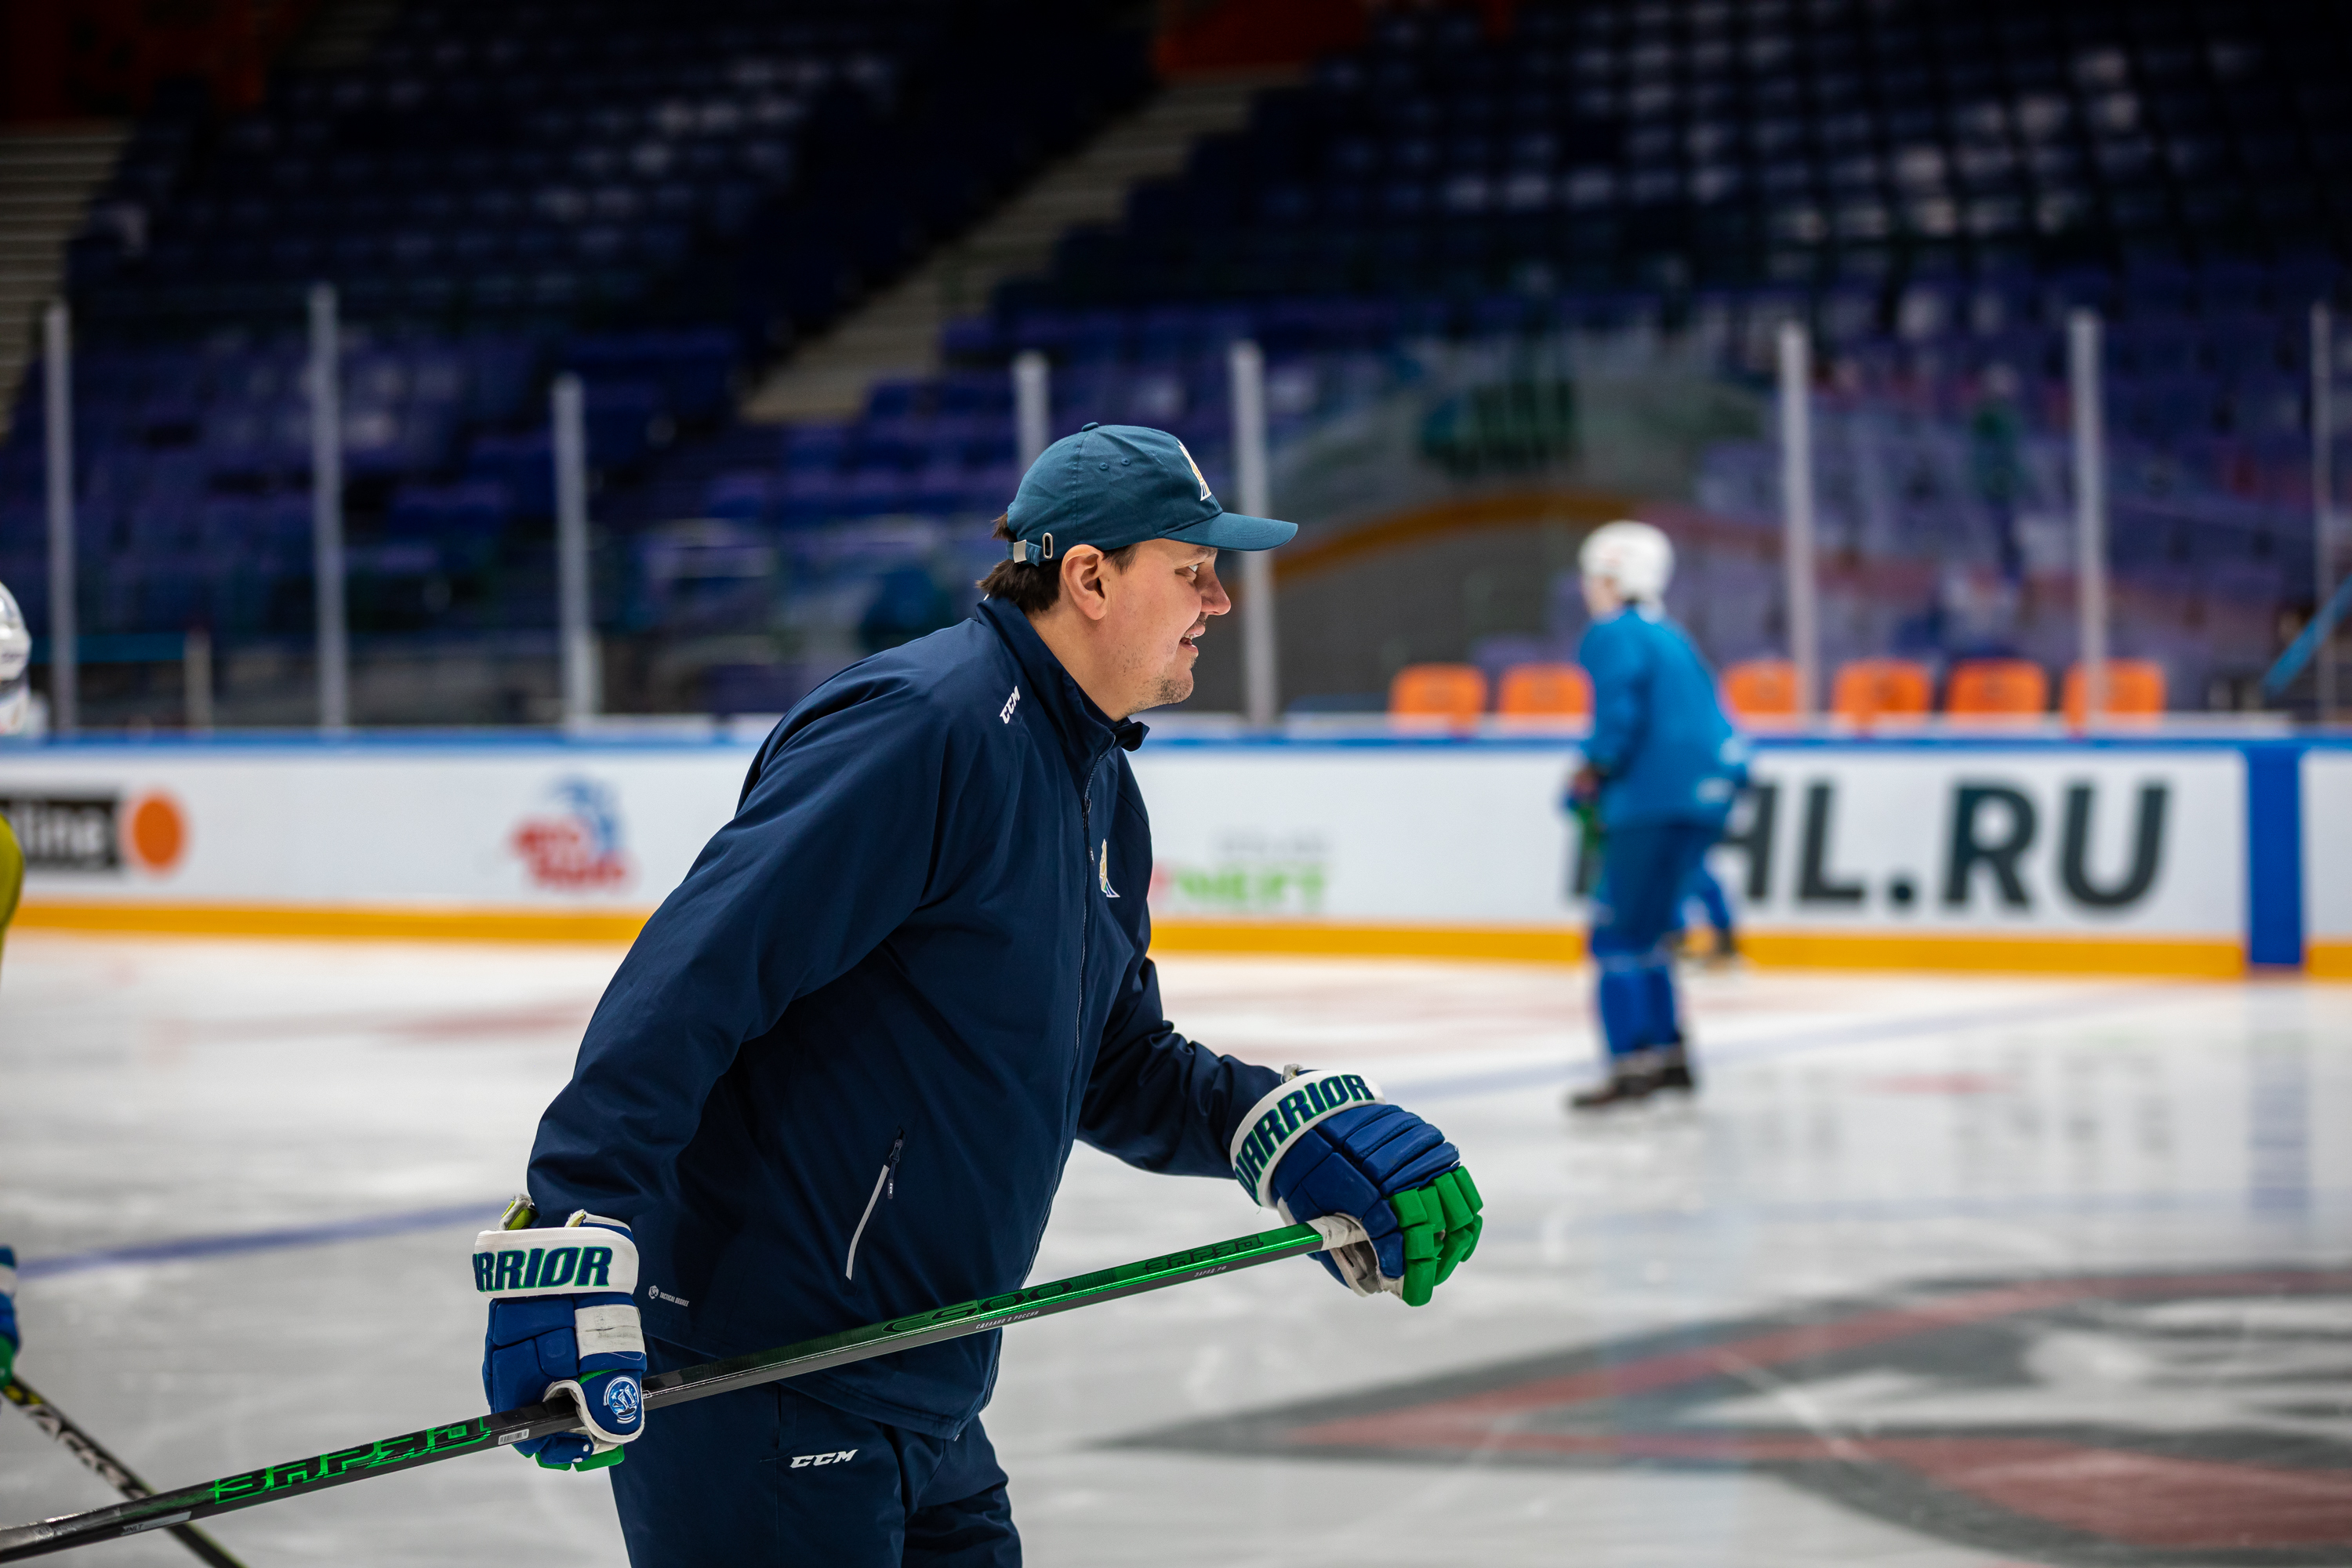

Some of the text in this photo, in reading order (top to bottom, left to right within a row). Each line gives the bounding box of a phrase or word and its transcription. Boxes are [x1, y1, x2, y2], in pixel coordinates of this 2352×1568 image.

[999, 685, 1021, 724] CCM
[1570, 778, 2172, 911] HL.RU
[472, 1246, 614, 1293] RRIOR
[1194, 1265, 1228, 1279] ЗАРЯД.РФ
[975, 1318, 1006, 1330] СДЕЛАНО
[1013, 1310, 1040, 1321] РОССИИ
[789, 1448, 859, 1469] CCM
